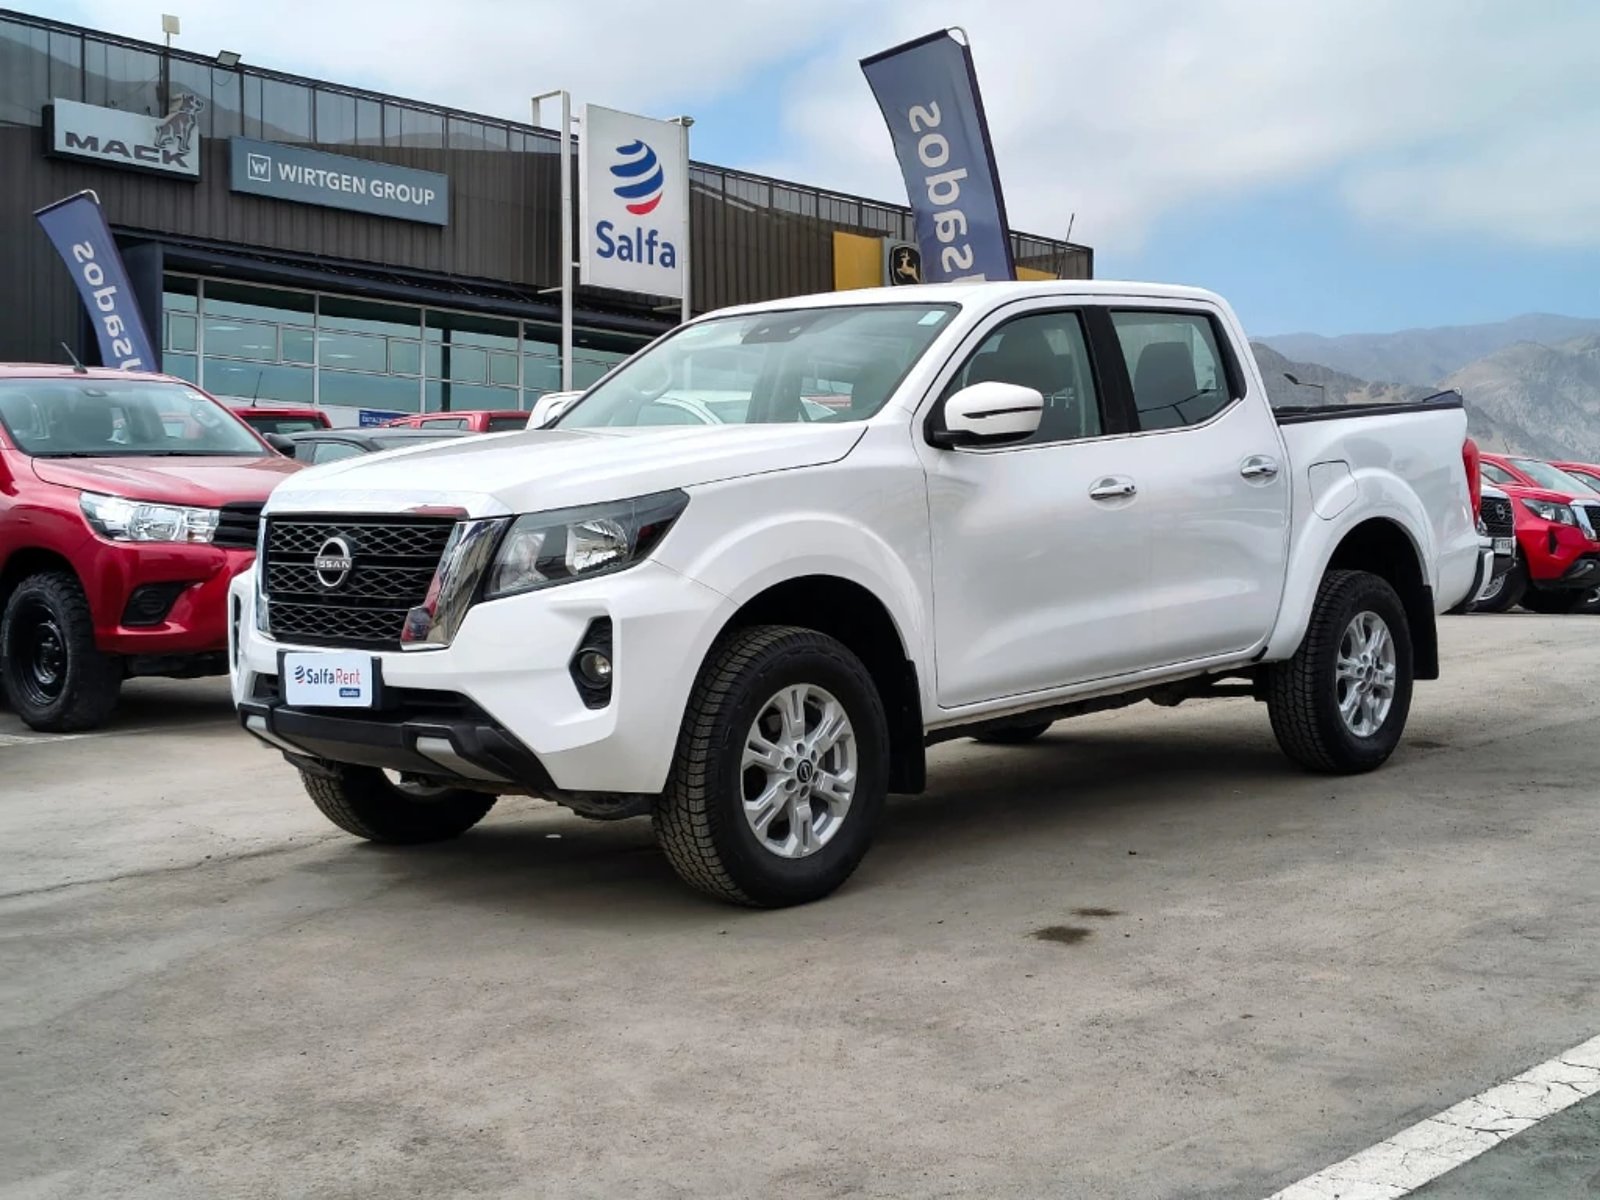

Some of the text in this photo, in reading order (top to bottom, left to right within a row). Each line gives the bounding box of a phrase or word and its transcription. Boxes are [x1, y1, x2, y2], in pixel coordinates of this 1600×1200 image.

[65, 131, 188, 168] MACK
[278, 162, 435, 206] WIRTGEN GROUP
[596, 220, 676, 269] Salfa
[316, 559, 351, 569] SSAN
